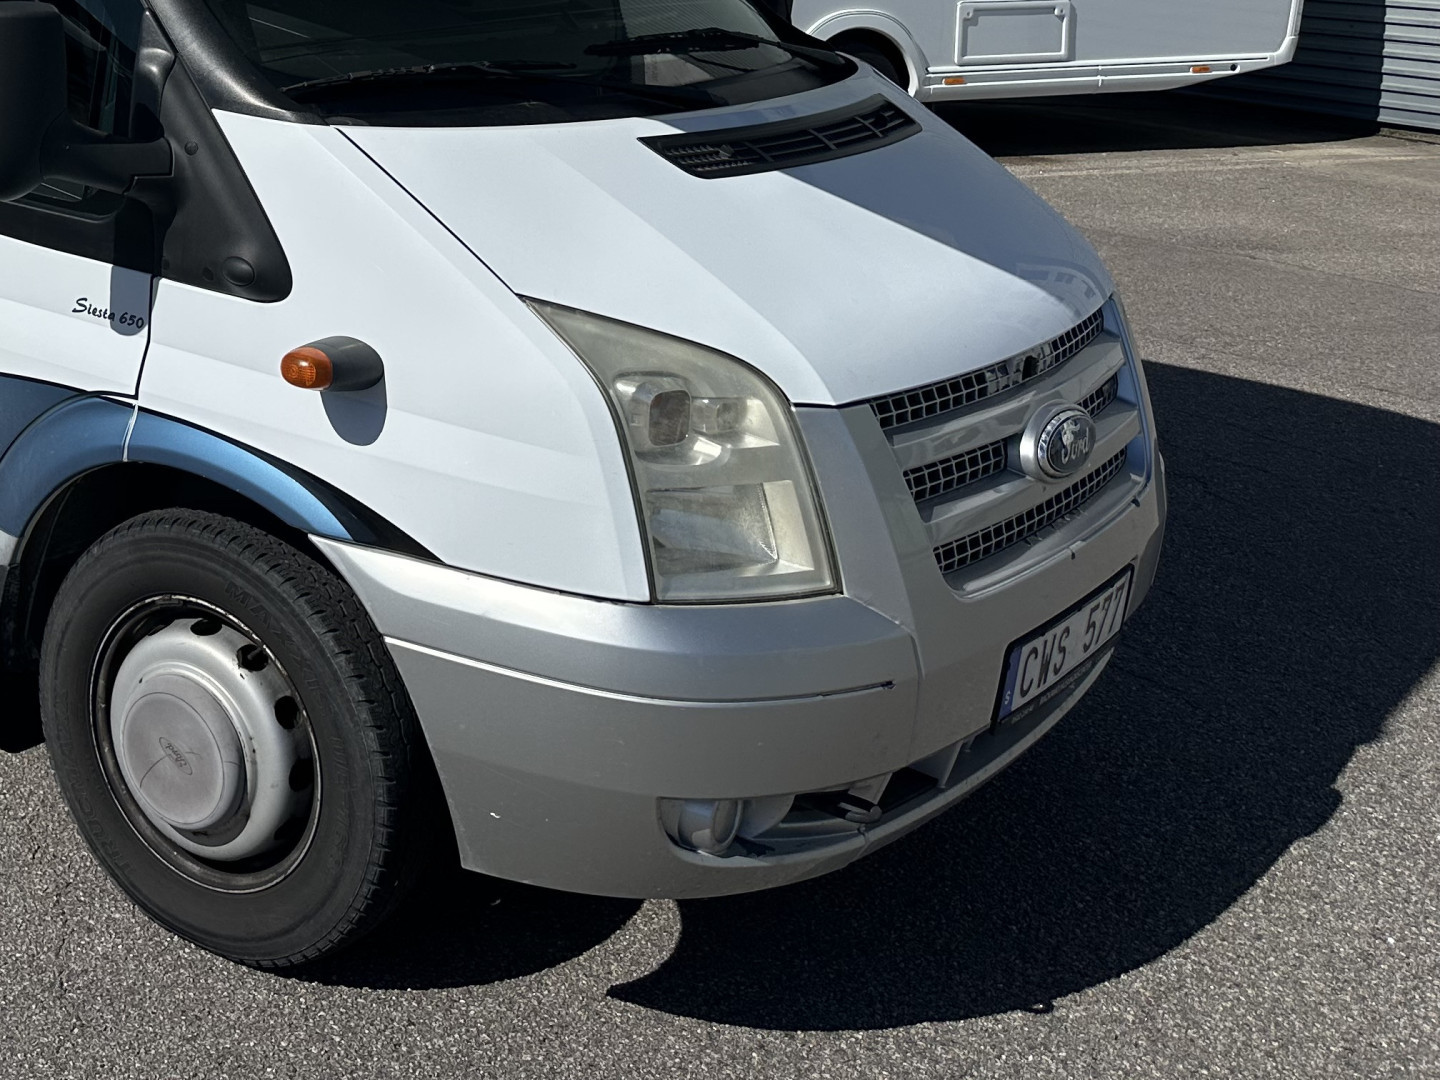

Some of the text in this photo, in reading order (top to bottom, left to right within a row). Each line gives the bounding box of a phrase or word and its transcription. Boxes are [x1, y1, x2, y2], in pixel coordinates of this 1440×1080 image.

[72, 297, 145, 329] Siesta 650
[1019, 626, 1071, 698] CWS
[1083, 582, 1126, 653] 577
